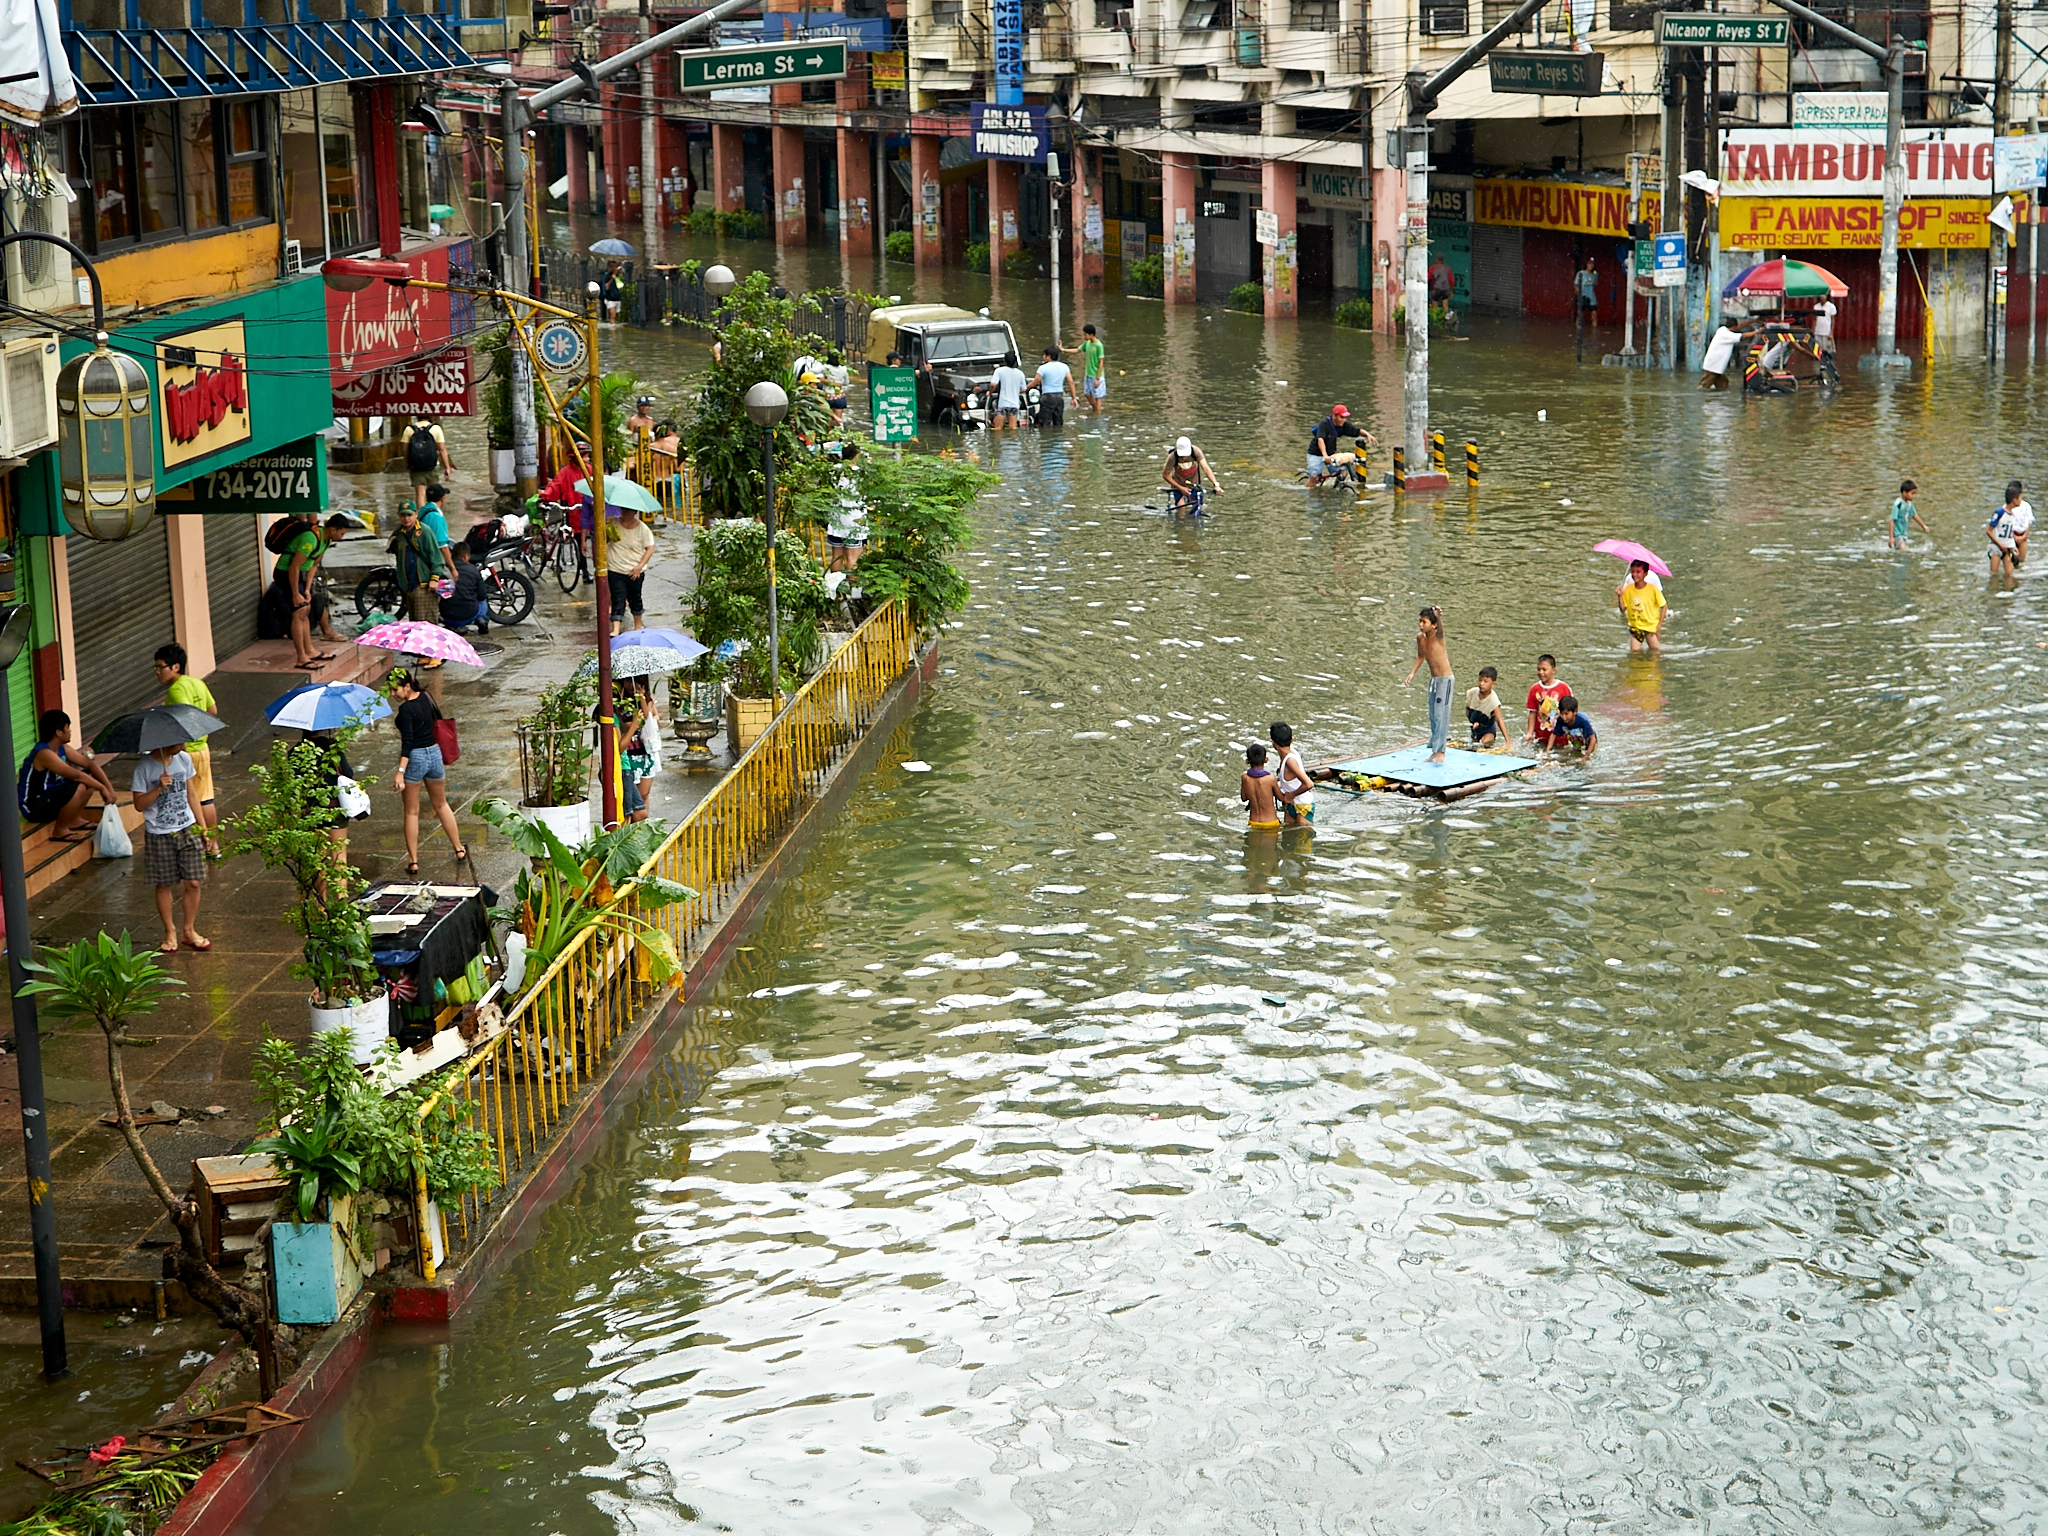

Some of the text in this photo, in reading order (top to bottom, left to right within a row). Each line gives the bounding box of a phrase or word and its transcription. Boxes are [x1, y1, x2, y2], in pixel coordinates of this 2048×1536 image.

[796, 24, 831, 40] ALIED
[1664, 22, 1770, 41] Nicanor Reyes St
[703, 56, 794, 80] Lerma St
[1493, 61, 1585, 86] Nicanor Reyes St
[982, 109, 1032, 132] ABLAZA
[1795, 107, 1835, 120] EXPRESS
[1838, 106, 1861, 120] PERA
[976, 132, 1039, 157] PAWNSHOP
[1312, 173, 1355, 197] MONEY
[1428, 191, 1461, 211] ABS
[1750, 206, 1942, 231] PAWNSHOP
[1948, 211, 1980, 224] SINCE
[1841, 232, 1913, 245] PAWNSOP
[340, 285, 420, 371] Chowking
[423, 362, 465, 395] 3655
[332, 402, 374, 415] owking
[386, 402, 465, 414] MORAYTA
[229, 454, 313, 468] eservations
[642, 438, 651, 488] NATIONAL
[203, 471, 311, 499] 734-2074
